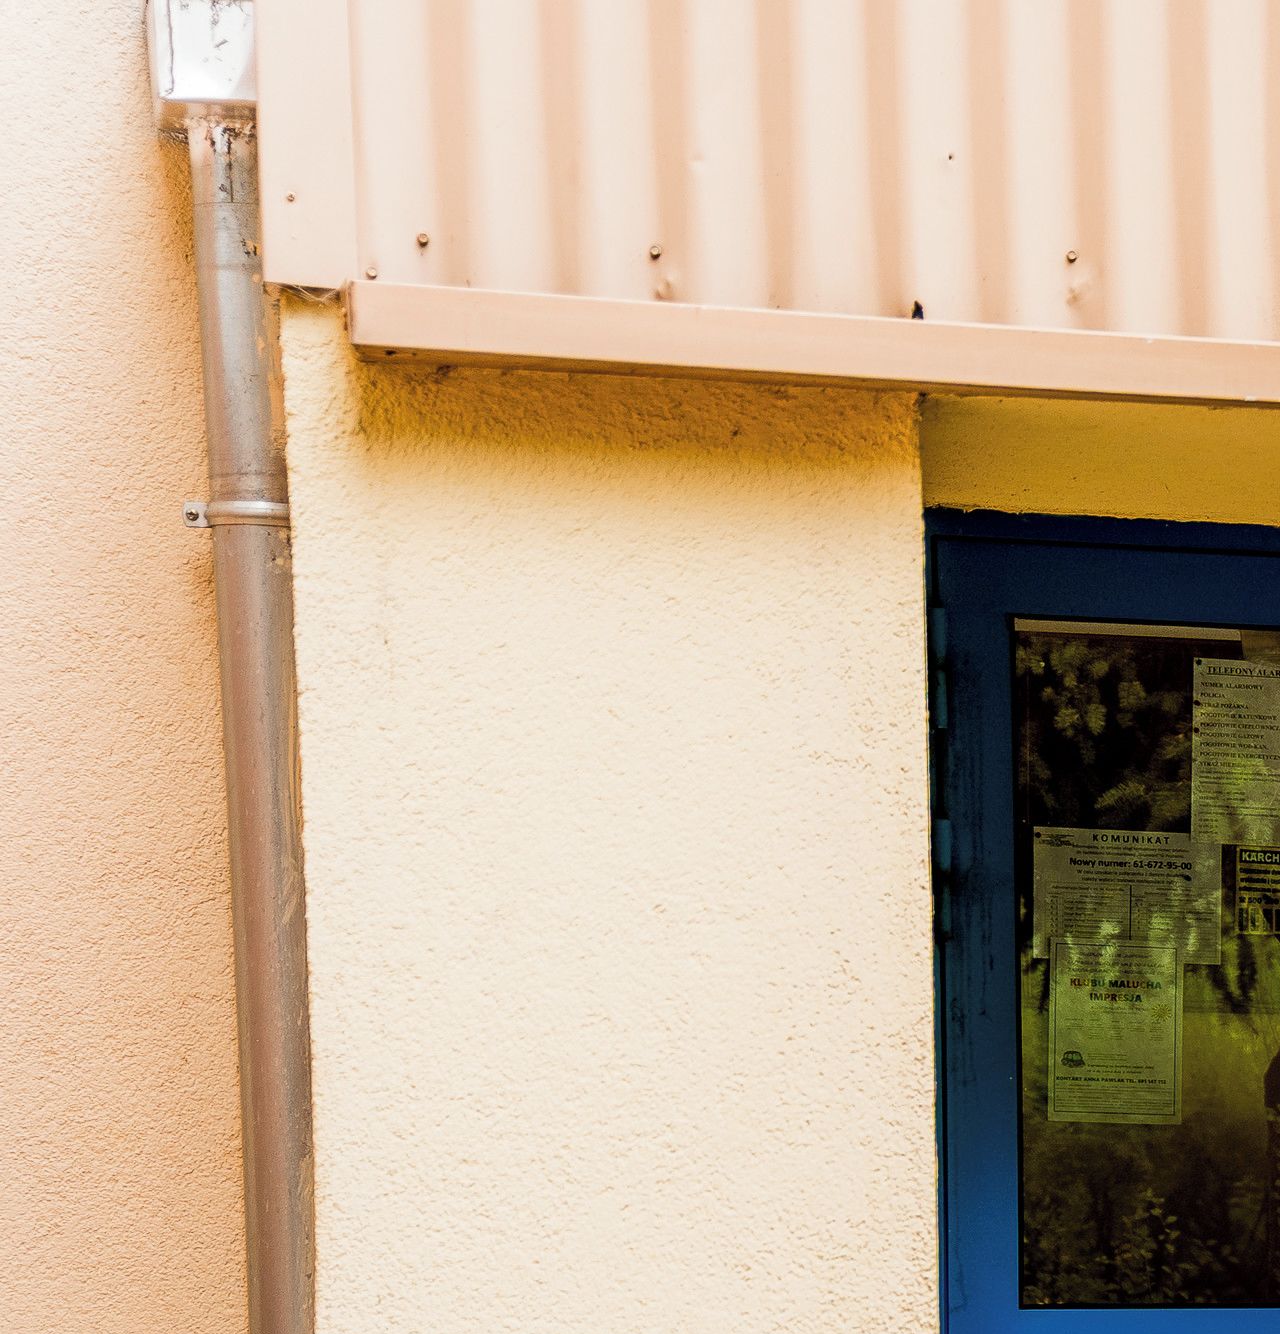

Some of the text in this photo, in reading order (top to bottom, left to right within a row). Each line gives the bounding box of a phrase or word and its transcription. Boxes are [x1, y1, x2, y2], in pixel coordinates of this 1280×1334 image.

[1207, 666, 1253, 676] TELEFONY
[1092, 834, 1170, 844] KOMUNIKAT
[1069, 857, 1192, 870] Nowy numer: 61-672-95-00
[1069, 978, 1162, 989] KLUBU MALUCHA
[1089, 992, 1142, 1003] IMPRESJA
